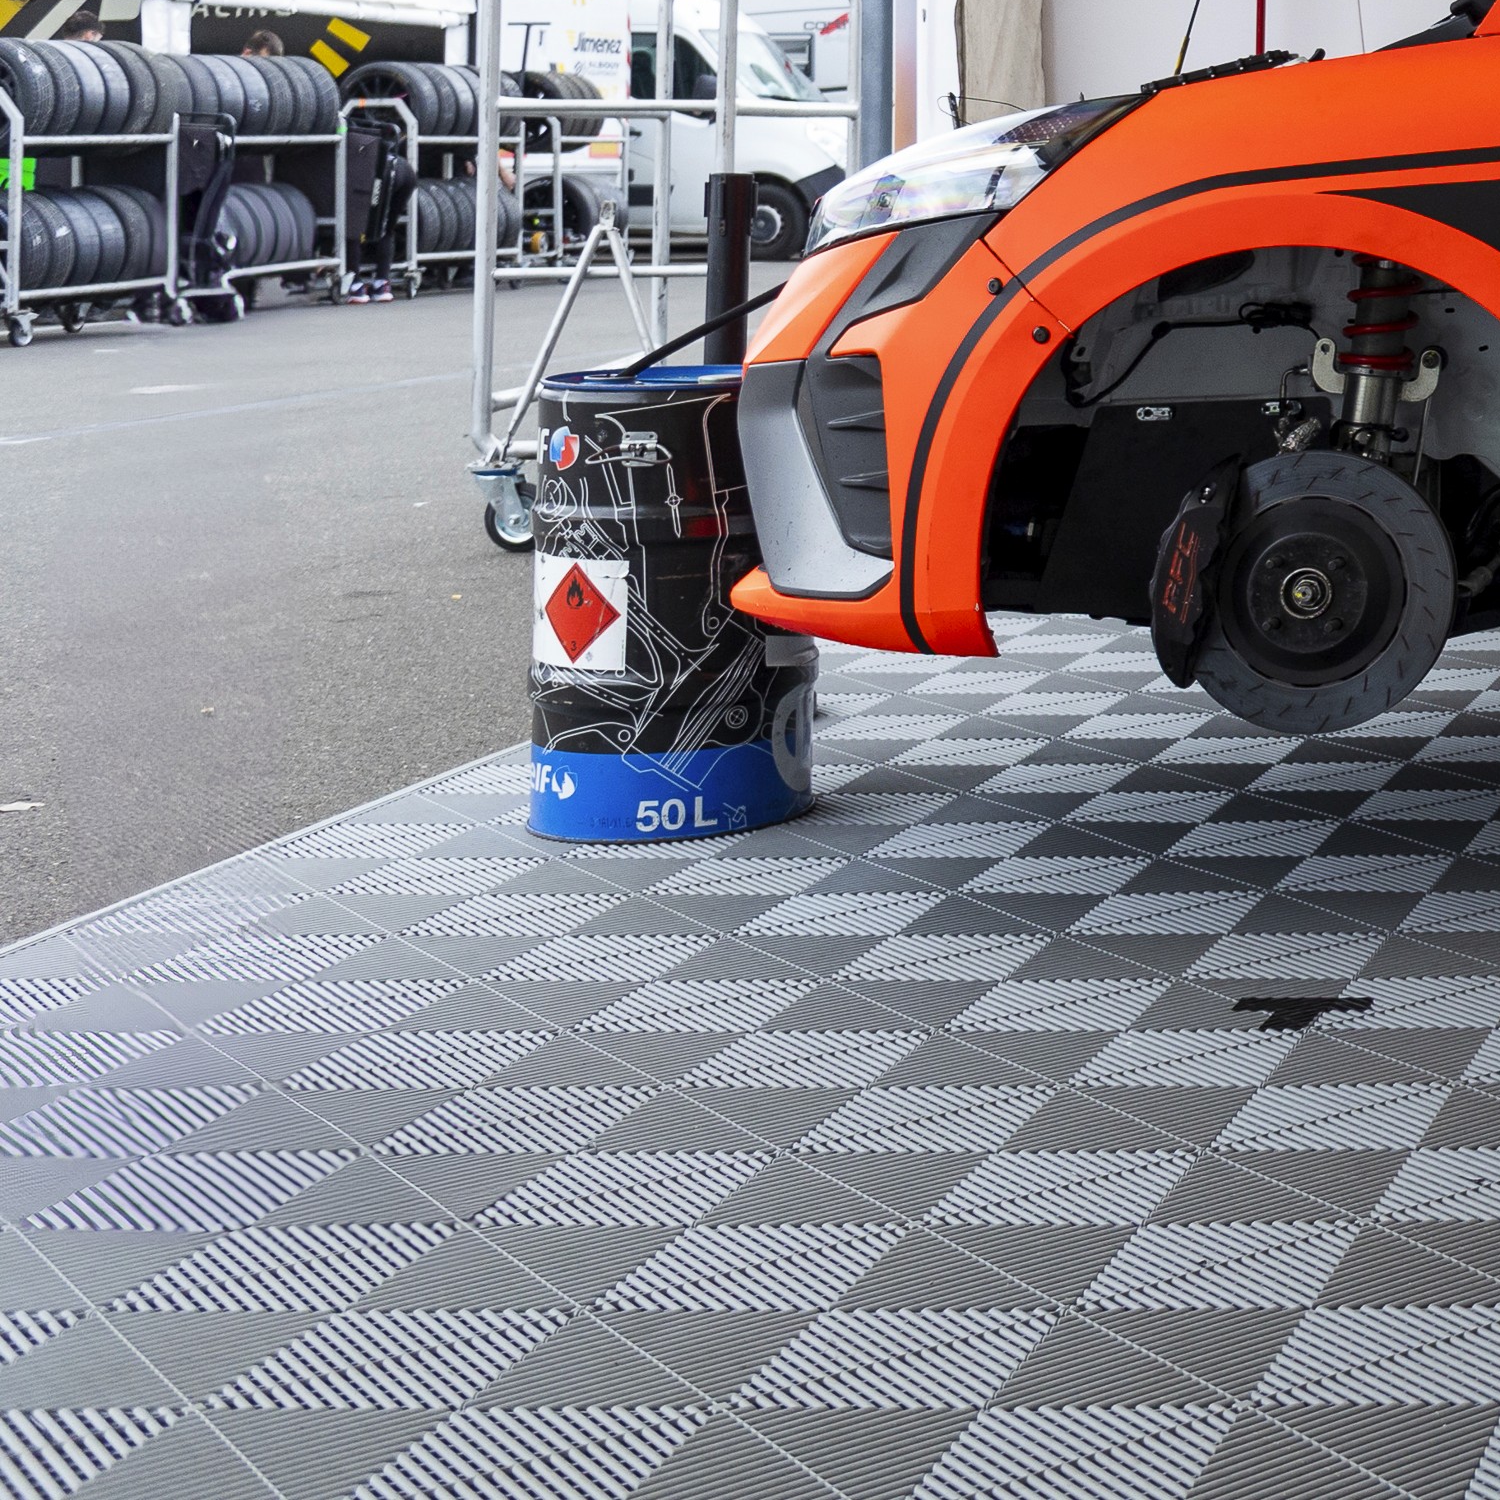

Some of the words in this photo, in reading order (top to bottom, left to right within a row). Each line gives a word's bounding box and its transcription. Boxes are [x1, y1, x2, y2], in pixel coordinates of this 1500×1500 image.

[571, 640, 578, 652] 3
[635, 798, 686, 833] 50
[694, 796, 718, 828] L
